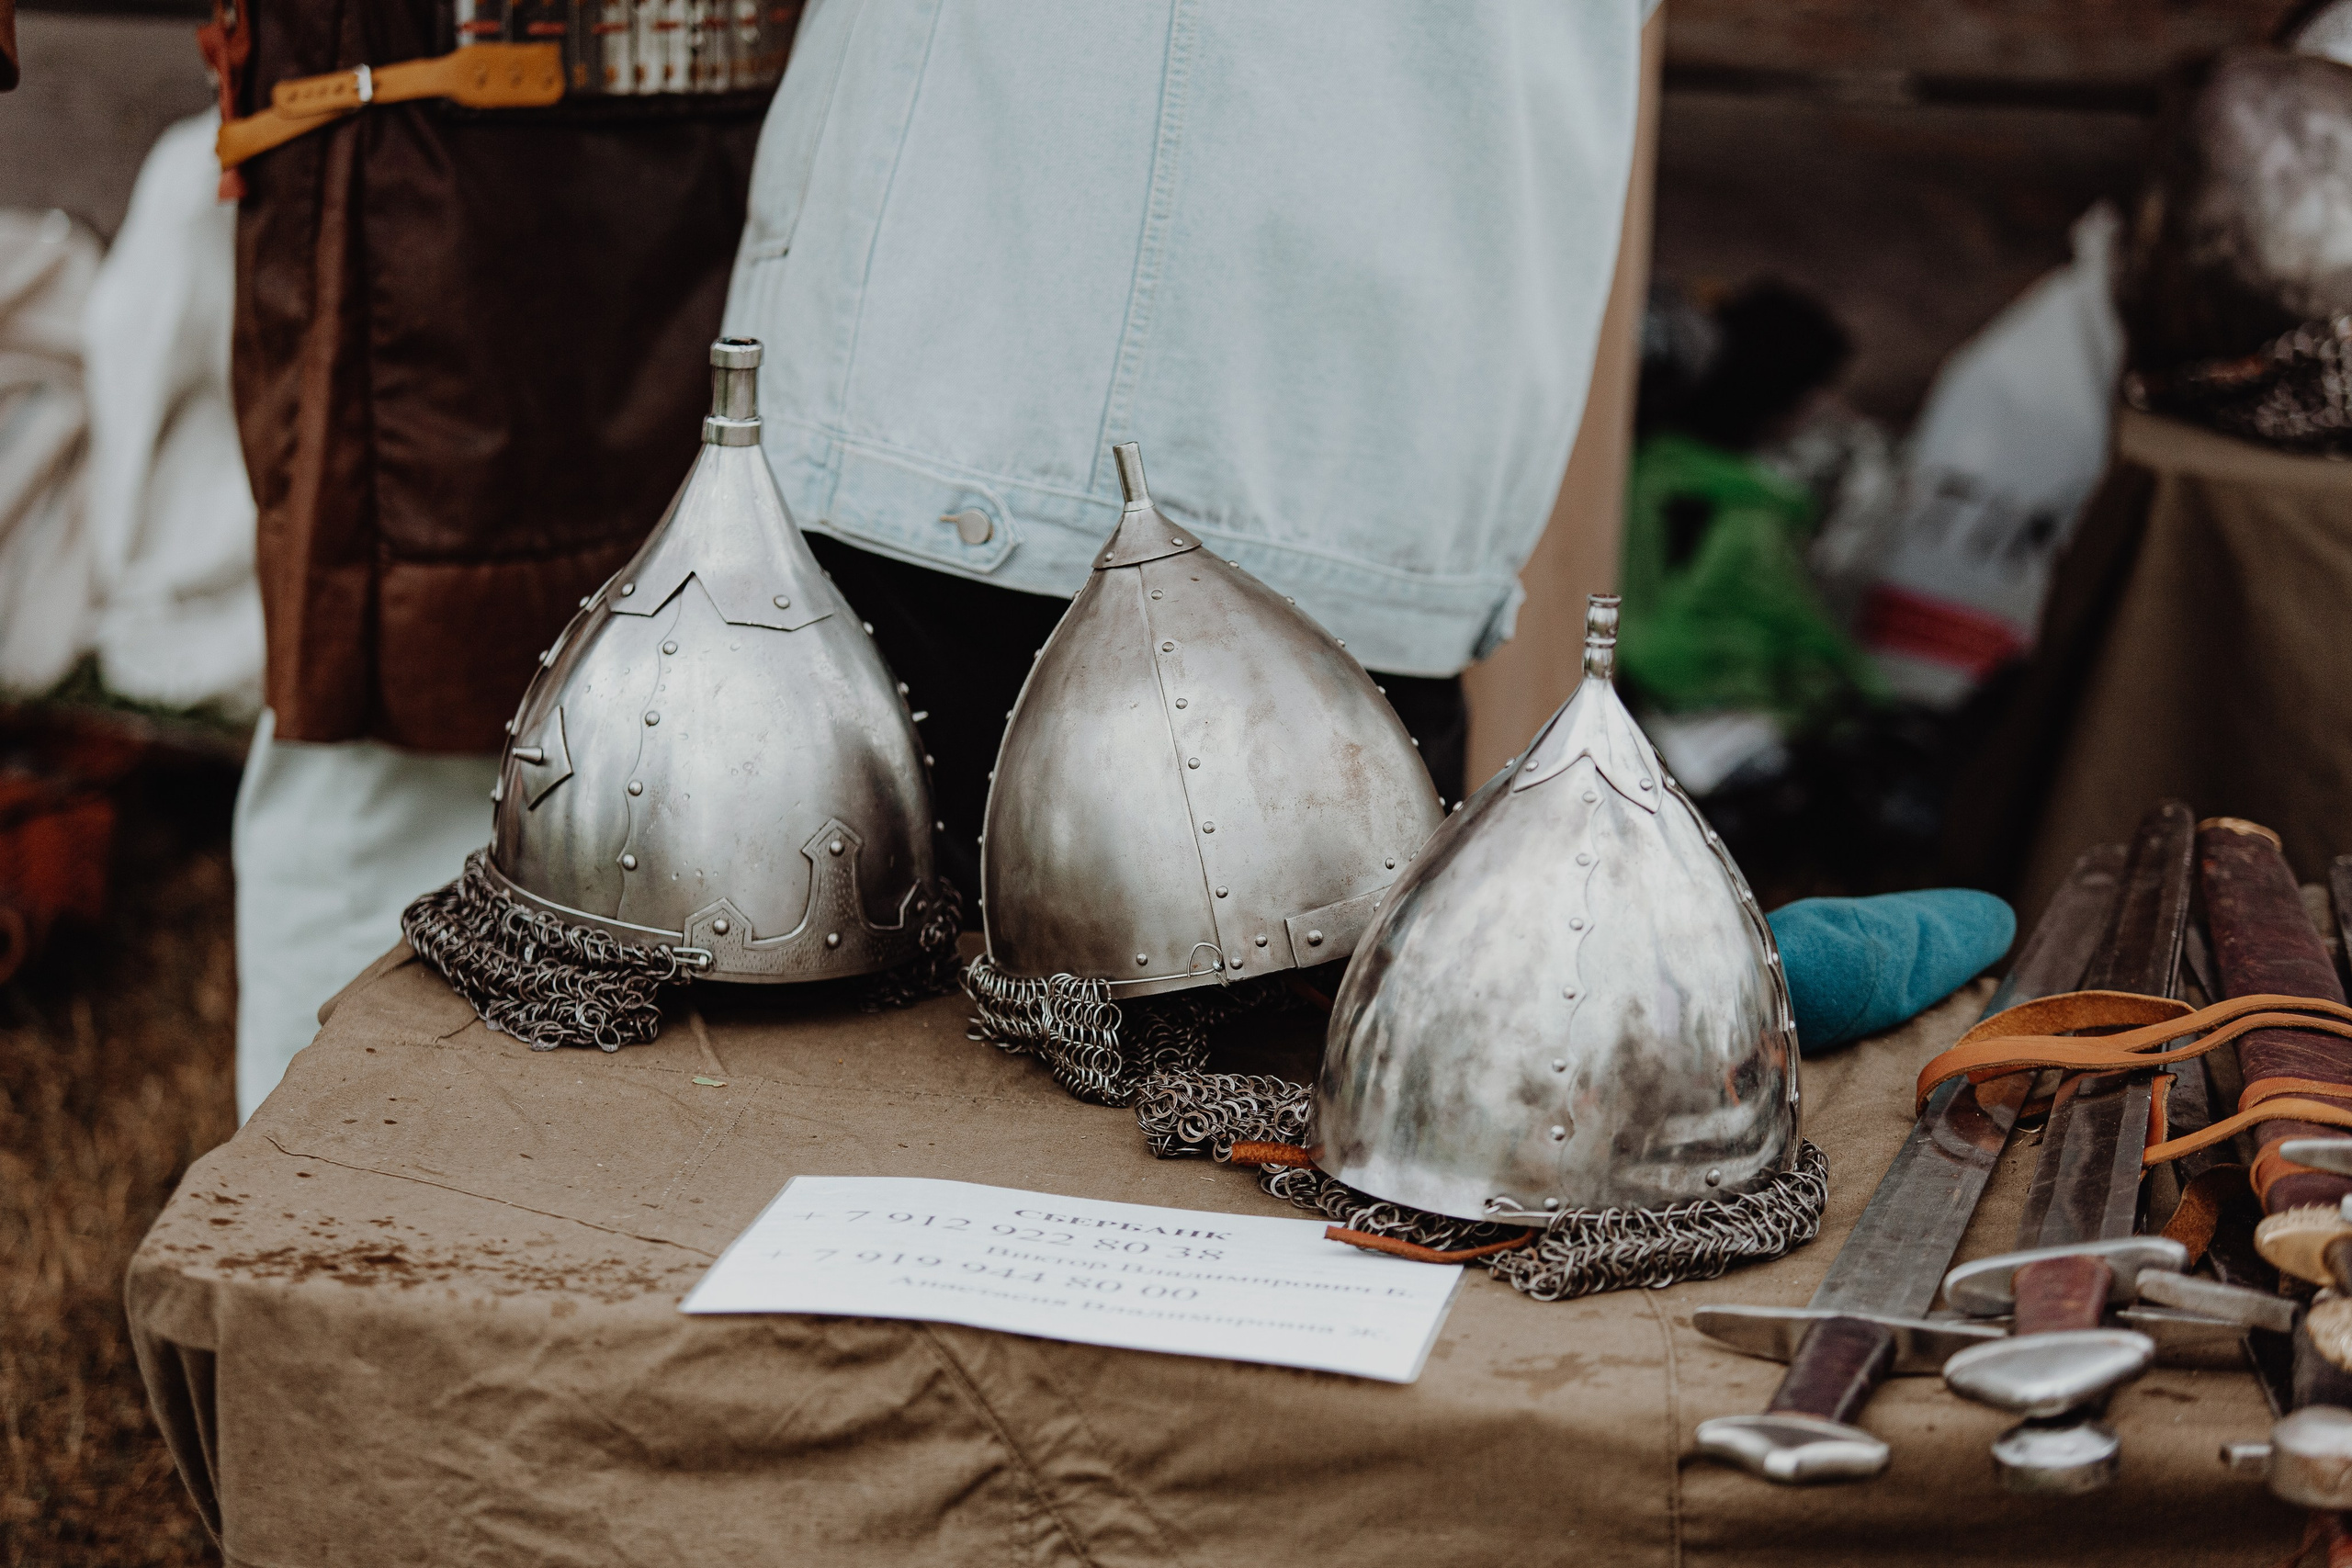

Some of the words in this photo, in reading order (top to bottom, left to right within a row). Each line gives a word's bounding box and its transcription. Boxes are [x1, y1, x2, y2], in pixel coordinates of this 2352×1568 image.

[845, 1210, 871, 1223] 7
[888, 1211, 971, 1231] 912
[990, 1224, 1074, 1247] 922
[1093, 1238, 1150, 1255] 80
[1165, 1246, 1225, 1261] 38
[1014, 1209, 1232, 1240] СБЕРБАНК
[814, 1248, 841, 1262] 7
[854, 1249, 942, 1269] 919
[959, 1260, 1045, 1283] 944
[1064, 1275, 1123, 1293] 80
[1140, 1285, 1199, 1302] 00
[986, 1245, 1108, 1271] Виктор
